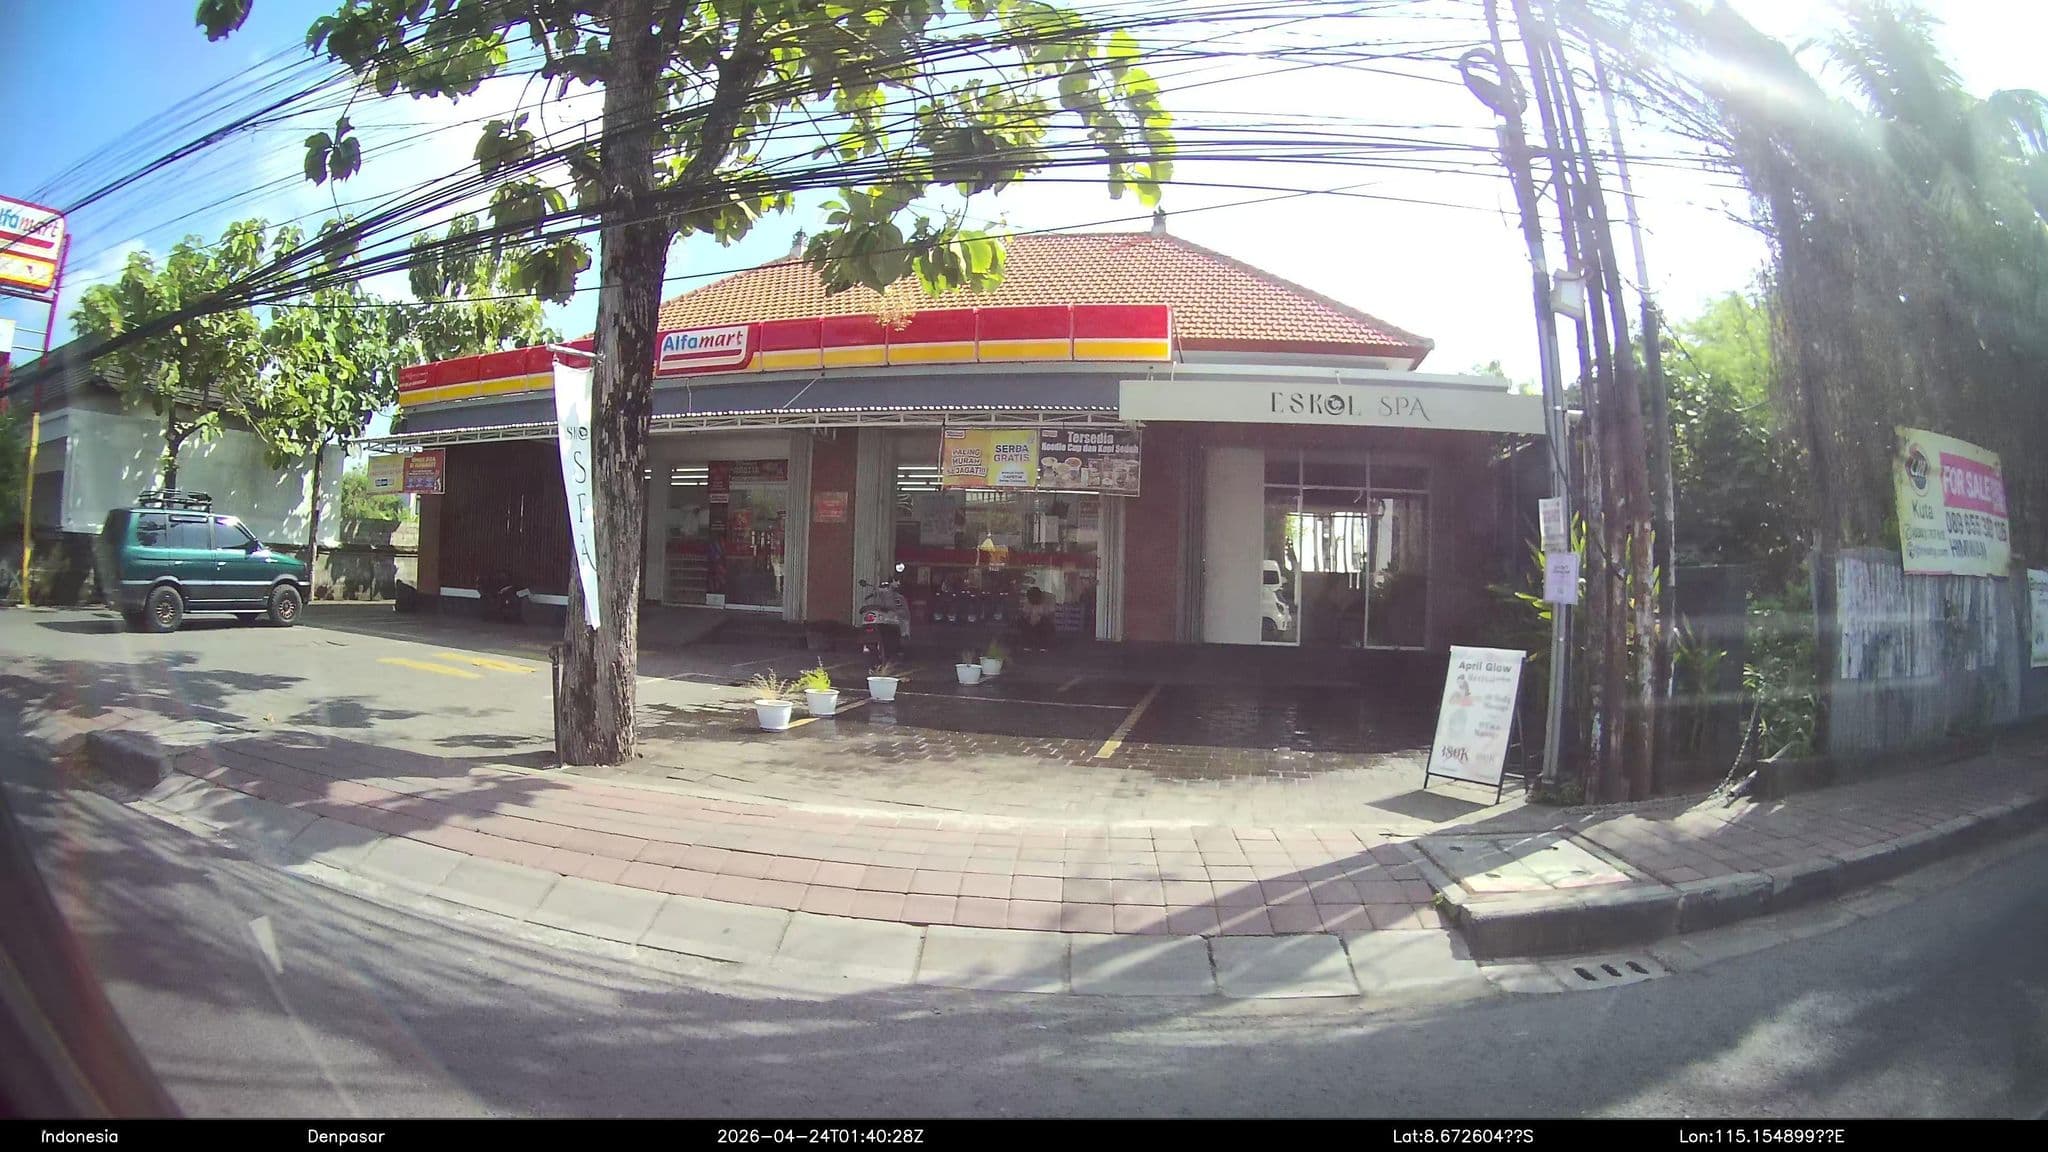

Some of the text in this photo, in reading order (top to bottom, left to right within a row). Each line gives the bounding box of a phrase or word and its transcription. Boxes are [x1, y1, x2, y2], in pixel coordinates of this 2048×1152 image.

[0, 207, 60, 238] lfamart
[663, 330, 743, 351] Alfamart
[1271, 391, 1432, 422] ESKOL SPA
[1067, 430, 1114, 444] Tersedia
[993, 454, 1030, 462] GRATIS
[995, 444, 1029, 453] SERBA
[1943, 465, 1965, 496] FOR
[1965, 471, 1992, 503] SALE
[1912, 500, 1934, 519] Kuta
[1458, 661, 1512, 672] April Glow
